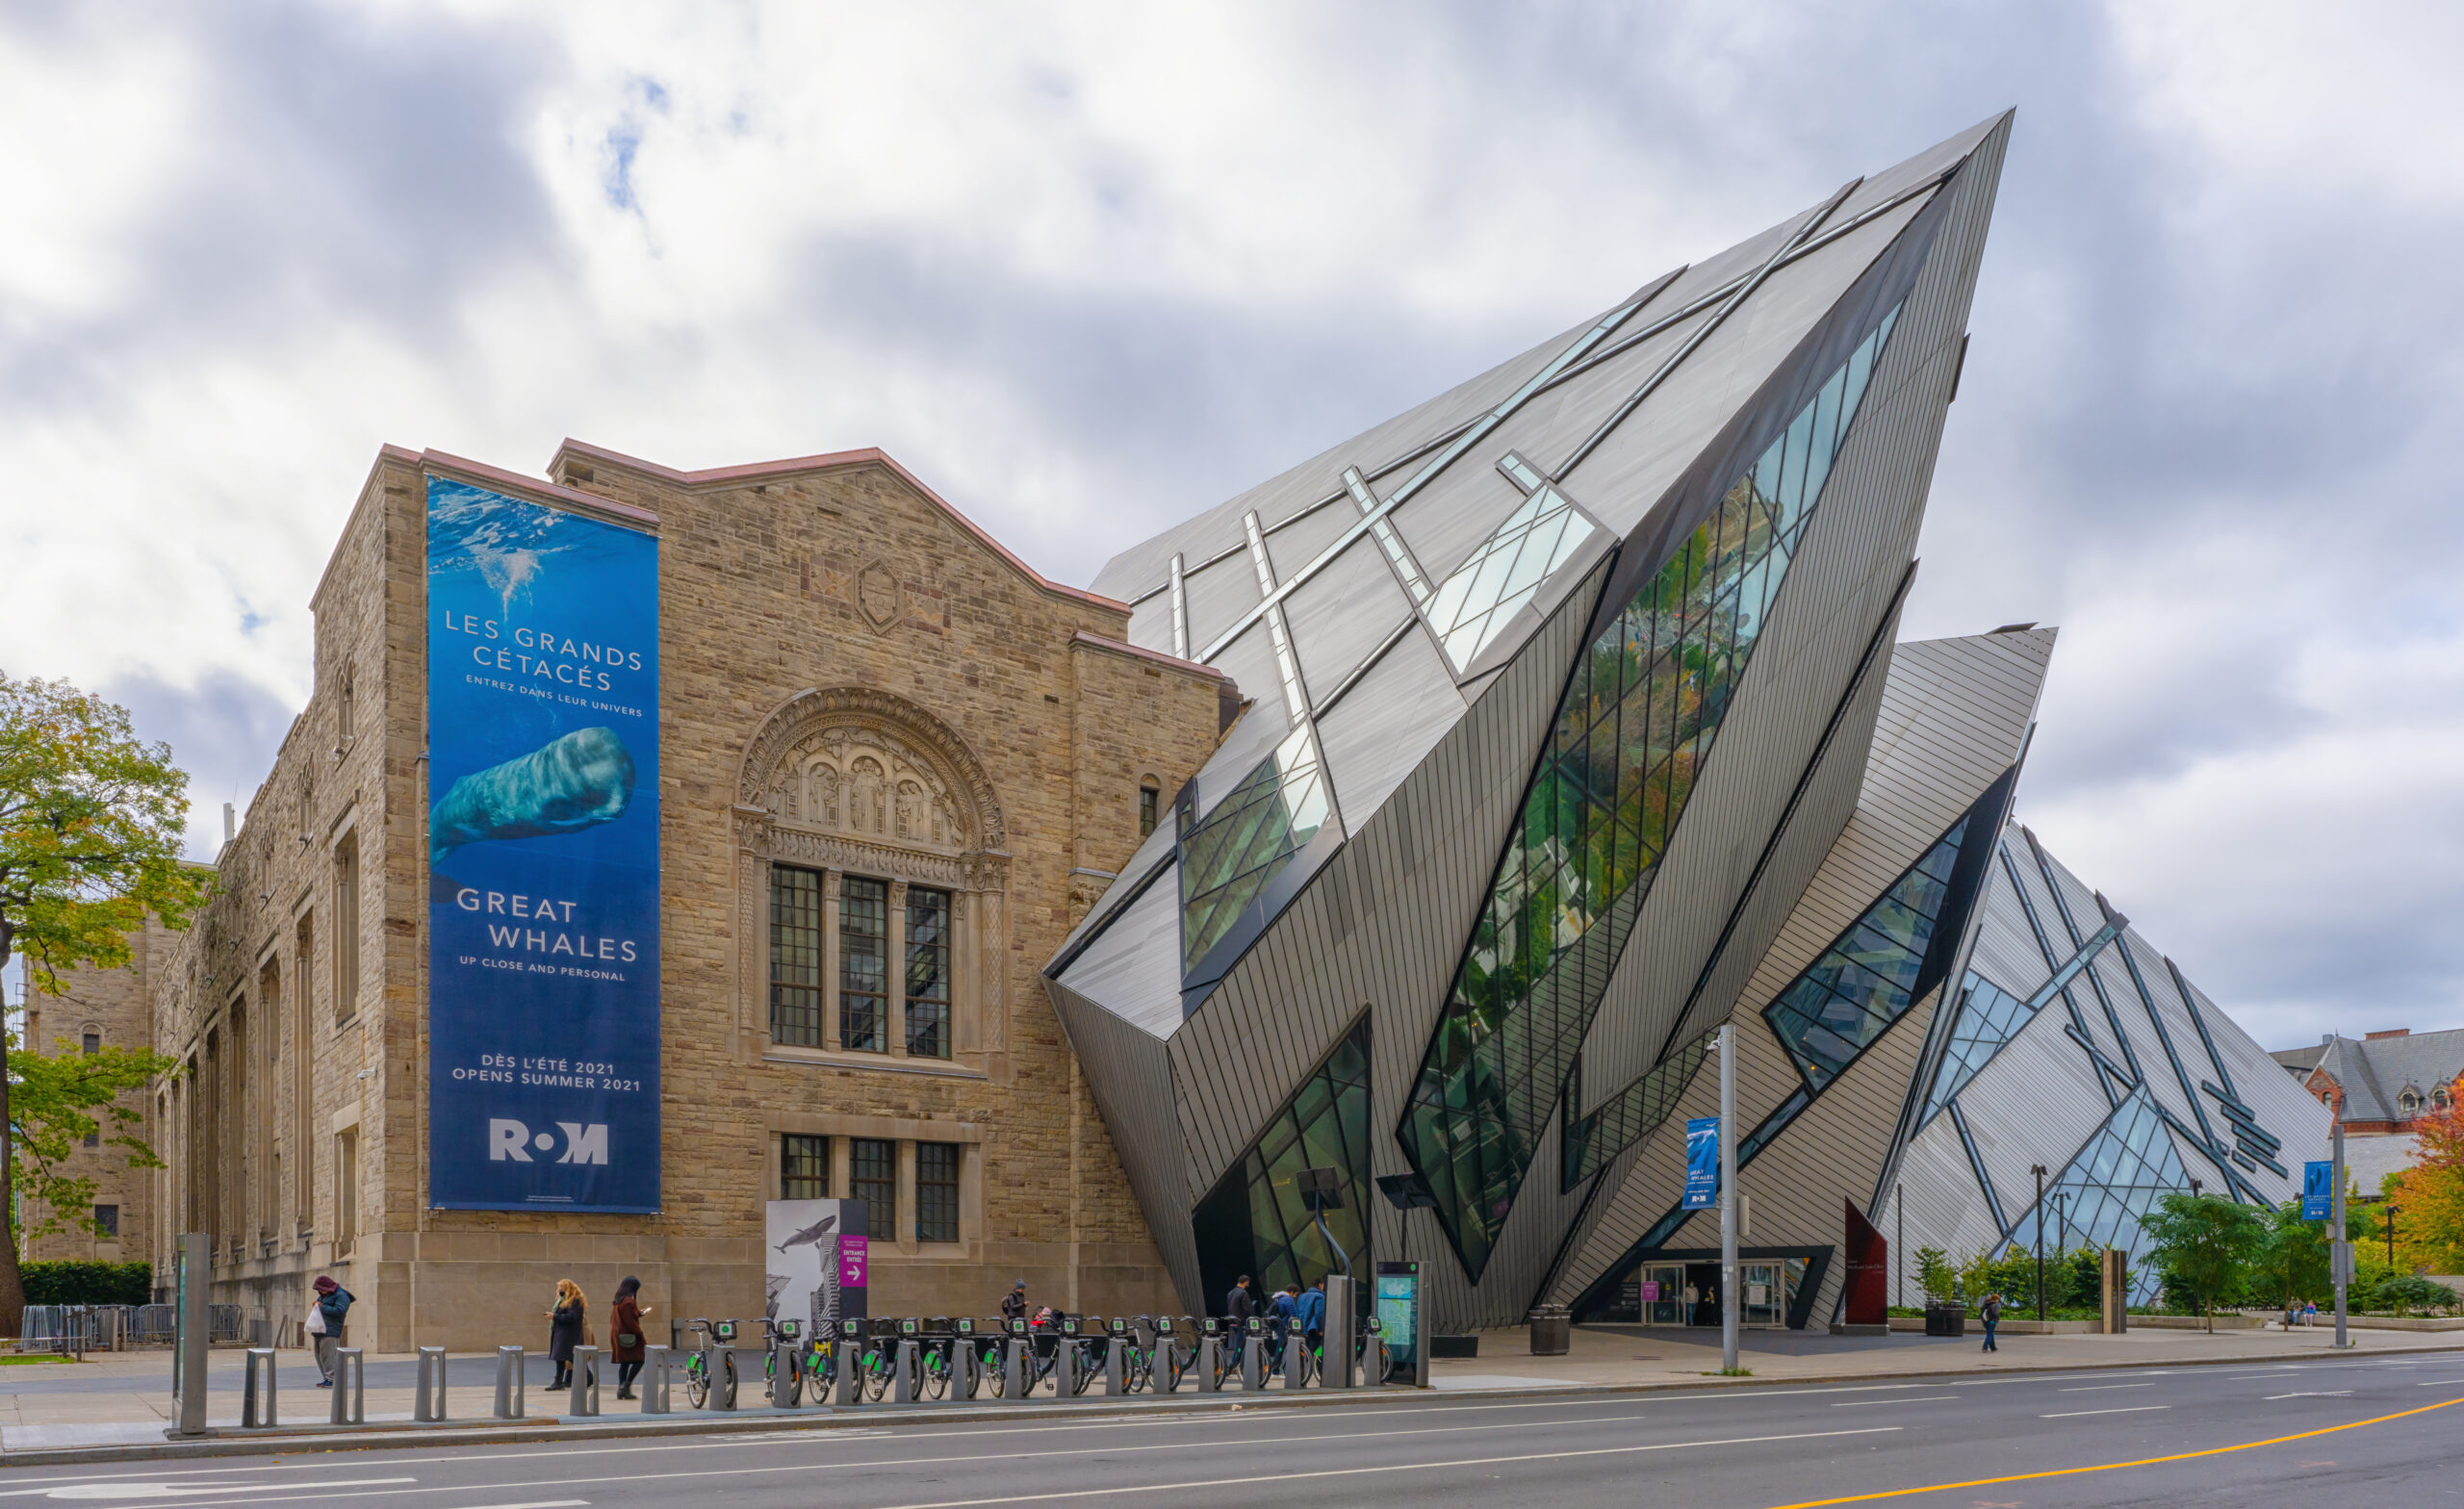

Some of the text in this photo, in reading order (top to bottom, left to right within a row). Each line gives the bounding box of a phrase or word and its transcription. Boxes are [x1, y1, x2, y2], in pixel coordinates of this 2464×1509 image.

[447, 610, 641, 671] LES GRANDS
[474, 646, 610, 691] CÉTACÉS
[466, 674, 642, 717] ENTREZ DANS LEUR UNIVERS
[456, 887, 577, 923] GREAT
[488, 924, 637, 962] WHALES
[459, 956, 626, 982] UP CLOSE AND PERSONAL
[452, 1067, 639, 1091] OPENS SUMMER 2021
[482, 1053, 516, 1068] DÈS
[576, 1061, 613, 1075] 2021
